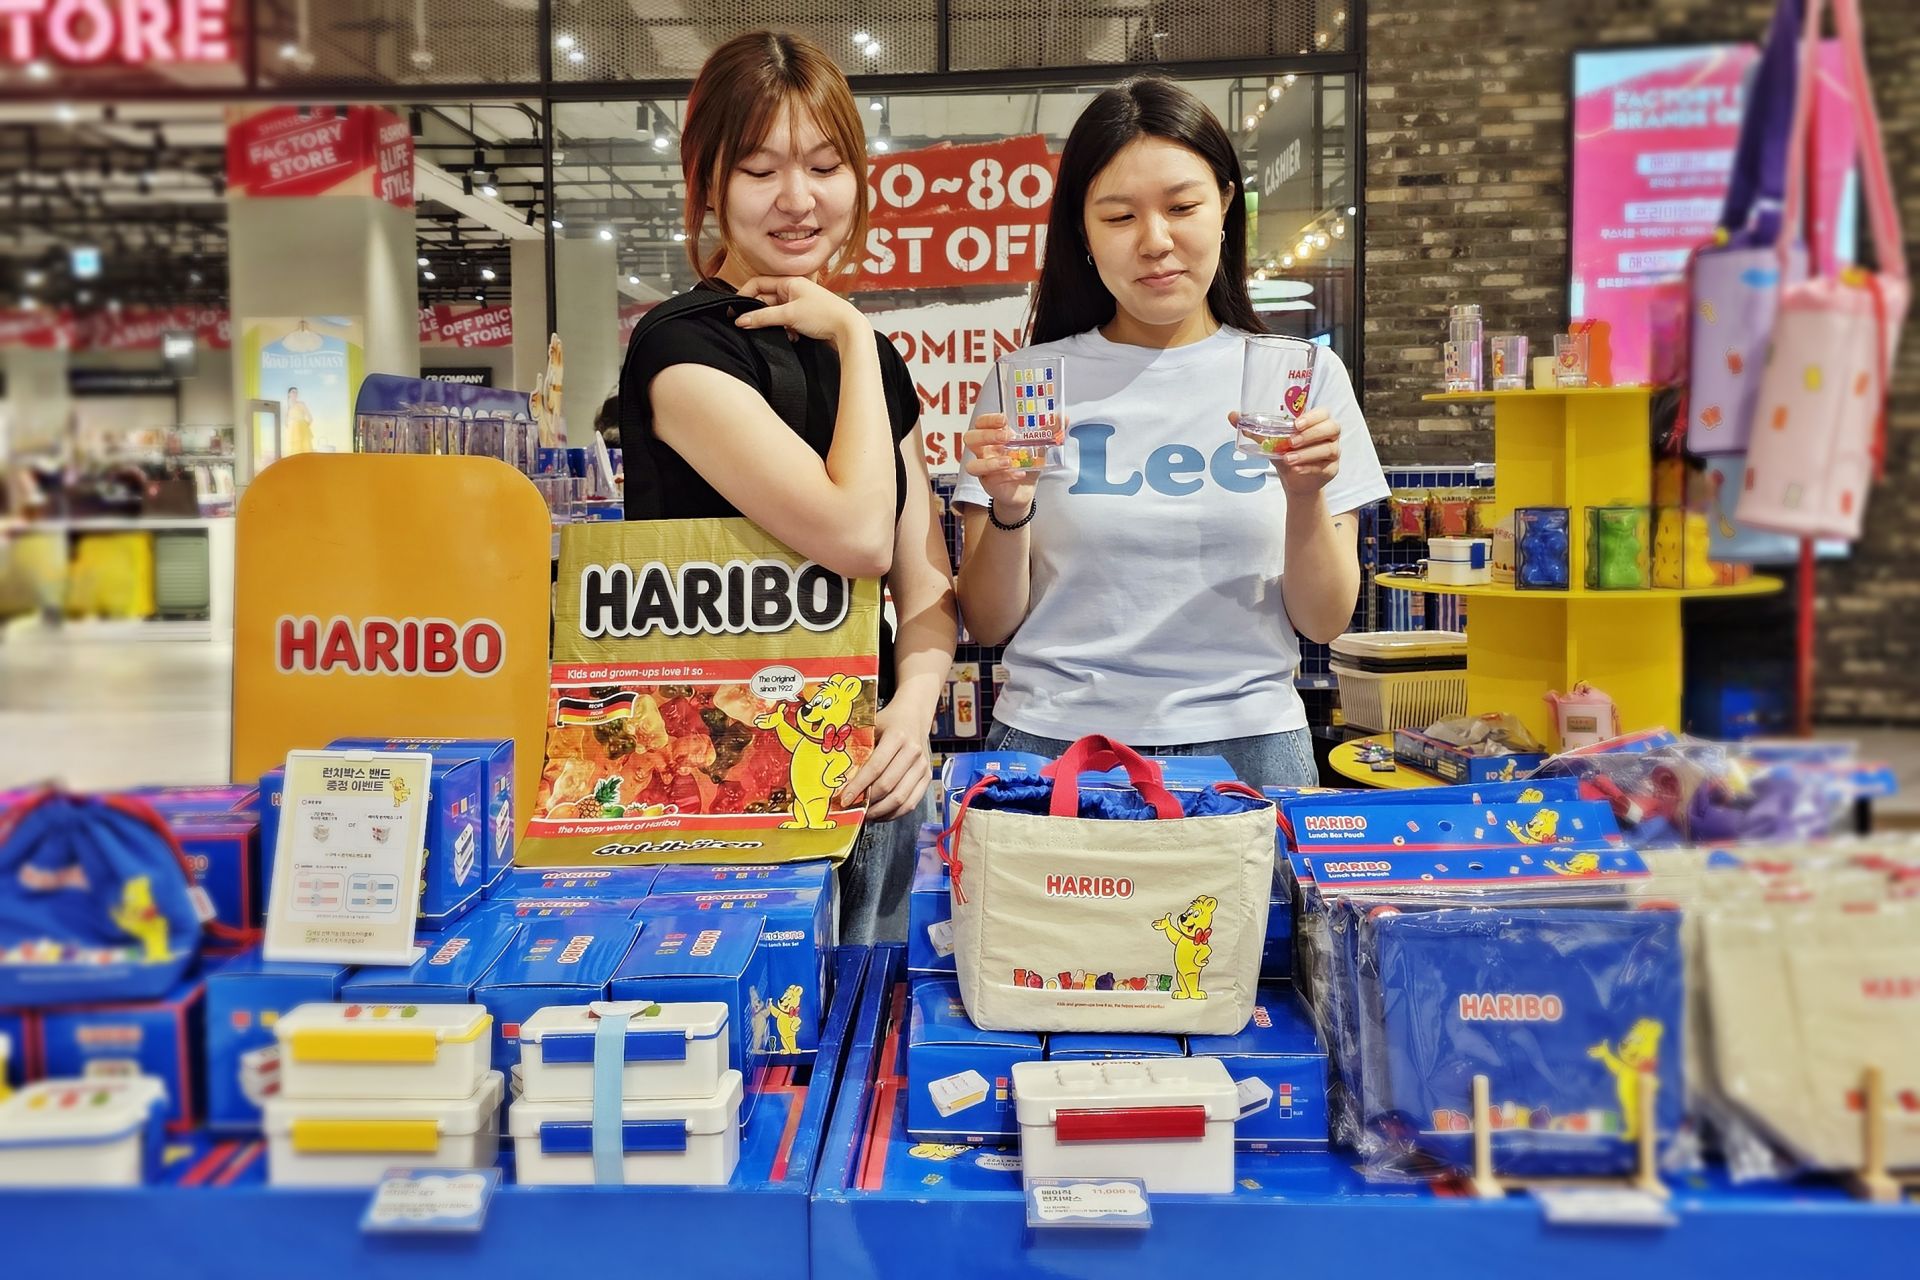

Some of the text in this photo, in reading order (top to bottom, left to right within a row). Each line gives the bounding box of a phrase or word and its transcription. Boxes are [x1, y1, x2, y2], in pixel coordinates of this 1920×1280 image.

[0, 0, 229, 62] TORE
[250, 124, 343, 166] FACTORY
[268, 146, 338, 180] STORE
[1264, 138, 1301, 196] CASHIER
[381, 171, 411, 202] STYLE
[442, 307, 513, 337] OFF PRIC
[461, 323, 513, 348] STORE
[439, 375, 485, 384] COMPANY
[1023, 430, 1052, 440] HARIBO
[1067, 423, 1271, 497] Lee
[582, 561, 848, 636] HARIBO
[278, 617, 504, 676] HARIBO
[567, 669, 588, 679] Kids
[590, 669, 609, 678] and
[610, 668, 660, 680] grown-ups
[662, 666, 681, 676] love
[683, 666, 690, 676] it
[692, 668, 703, 676] so
[771, 675, 796, 684] Original
[322, 767, 391, 780] 런치박스 밴드
[326, 780, 384, 792] 증정 이벤트
[558, 826, 573, 834] the
[575, 825, 605, 835] happy
[606, 823, 632, 832] world
[634, 822, 646, 830] of
[1305, 816, 1367, 831] HARIBO
[592, 838, 764, 856] Goldbären
[1324, 861, 1391, 873] HARIBO
[1045, 873, 1134, 899] HARIBO
[428, 938, 471, 966] HARIBO
[557, 935, 595, 964] HARIBO
[690, 930, 722, 957] HARIBO
[1459, 993, 1563, 1022] HARIBO
